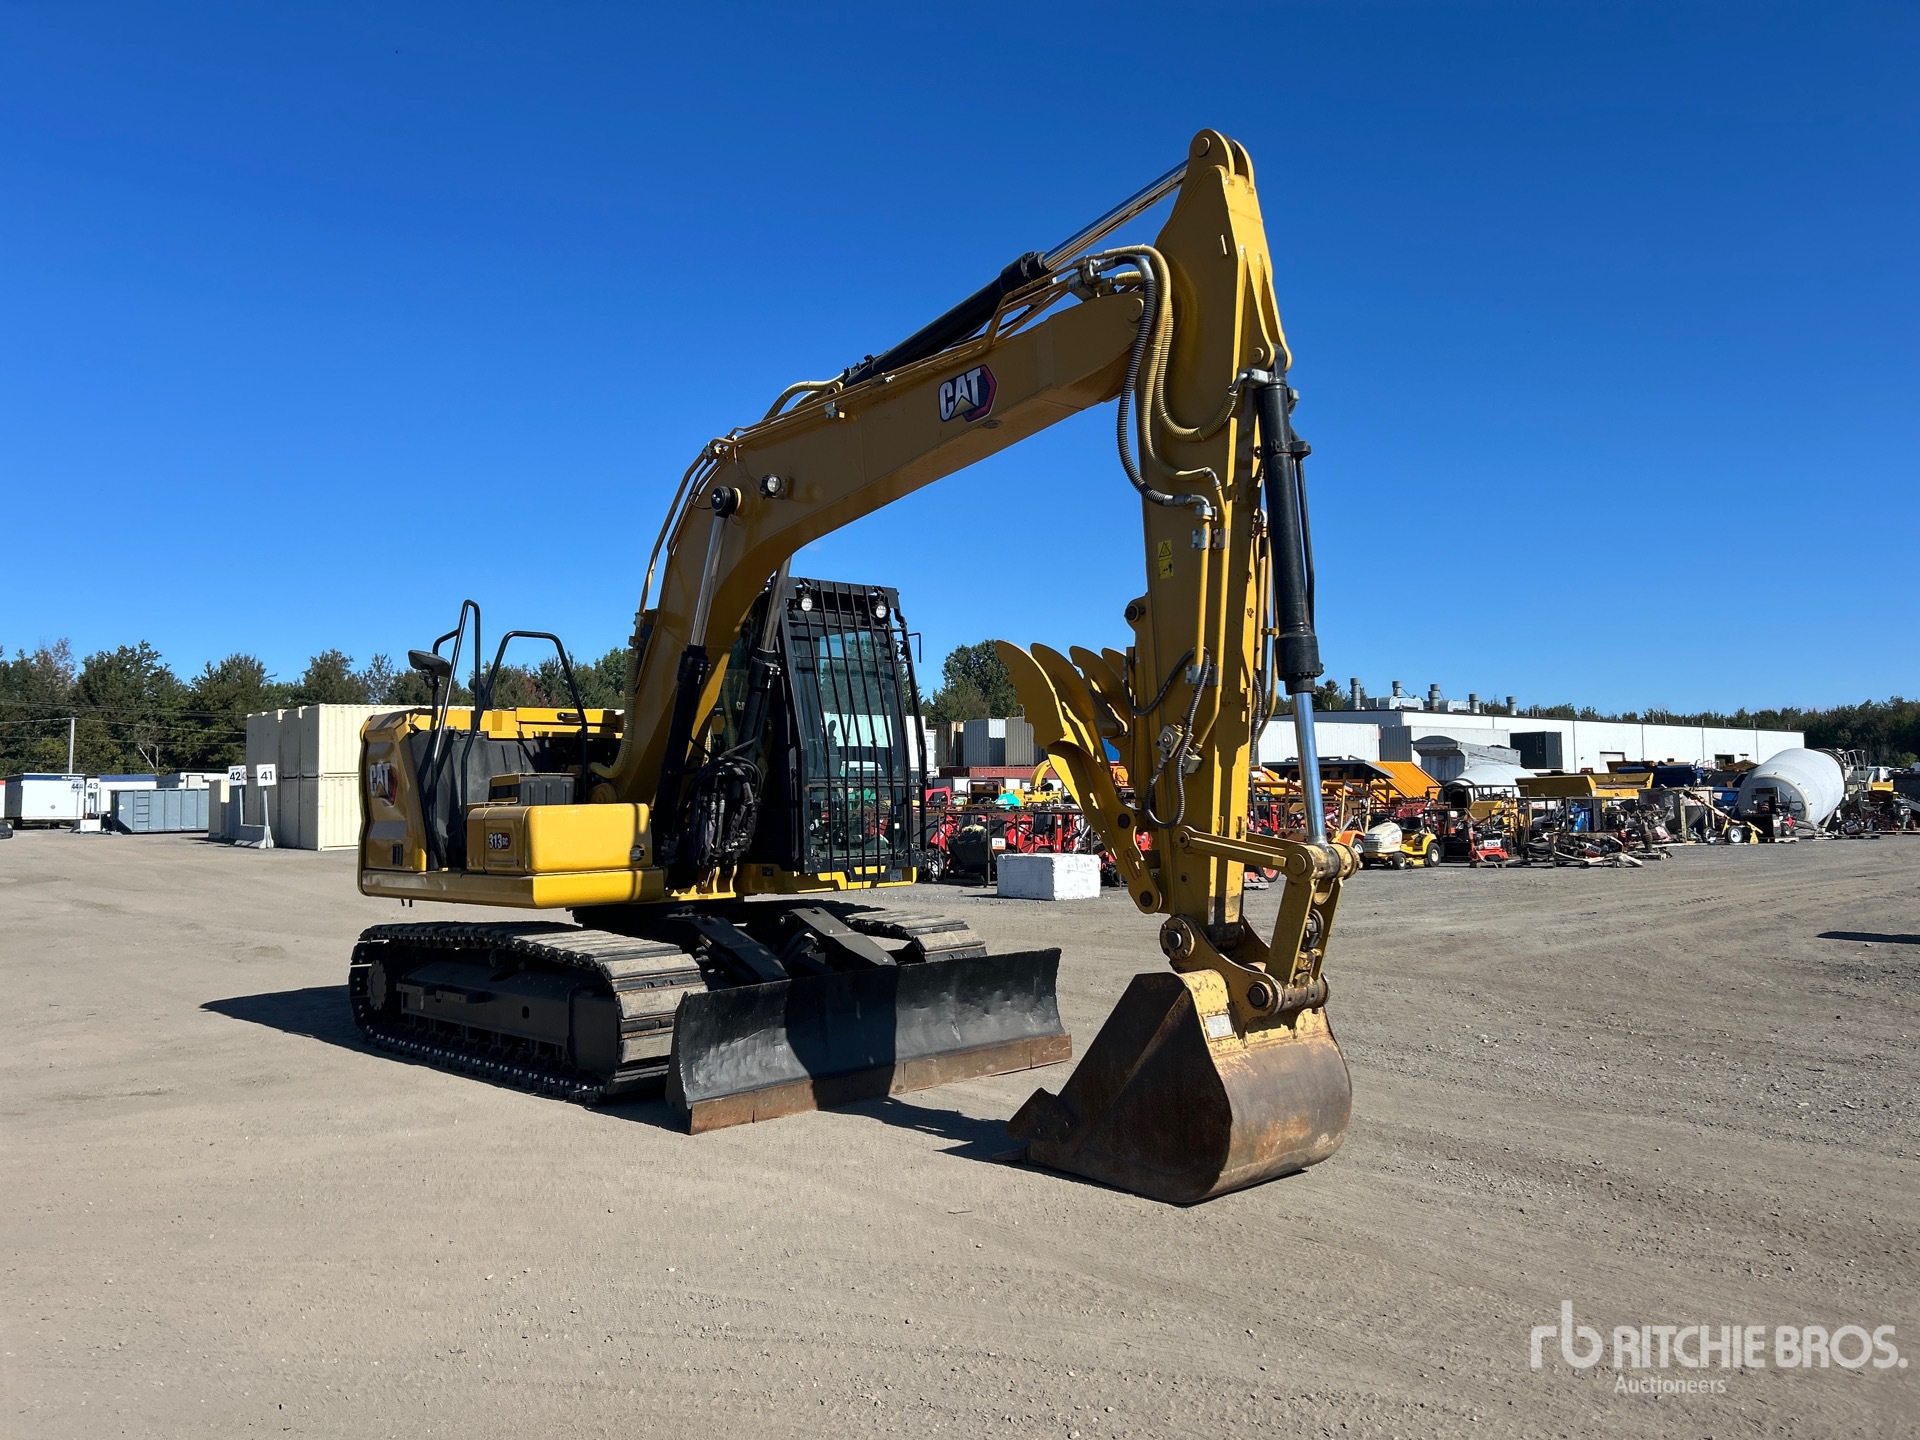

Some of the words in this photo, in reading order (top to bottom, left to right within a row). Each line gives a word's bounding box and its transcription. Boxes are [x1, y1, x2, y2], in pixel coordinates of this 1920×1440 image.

[939, 367, 980, 421] CAT
[230, 771, 241, 781] 42
[260, 770, 273, 780] 41
[370, 760, 391, 797] CAT
[87, 782, 98, 790] 43
